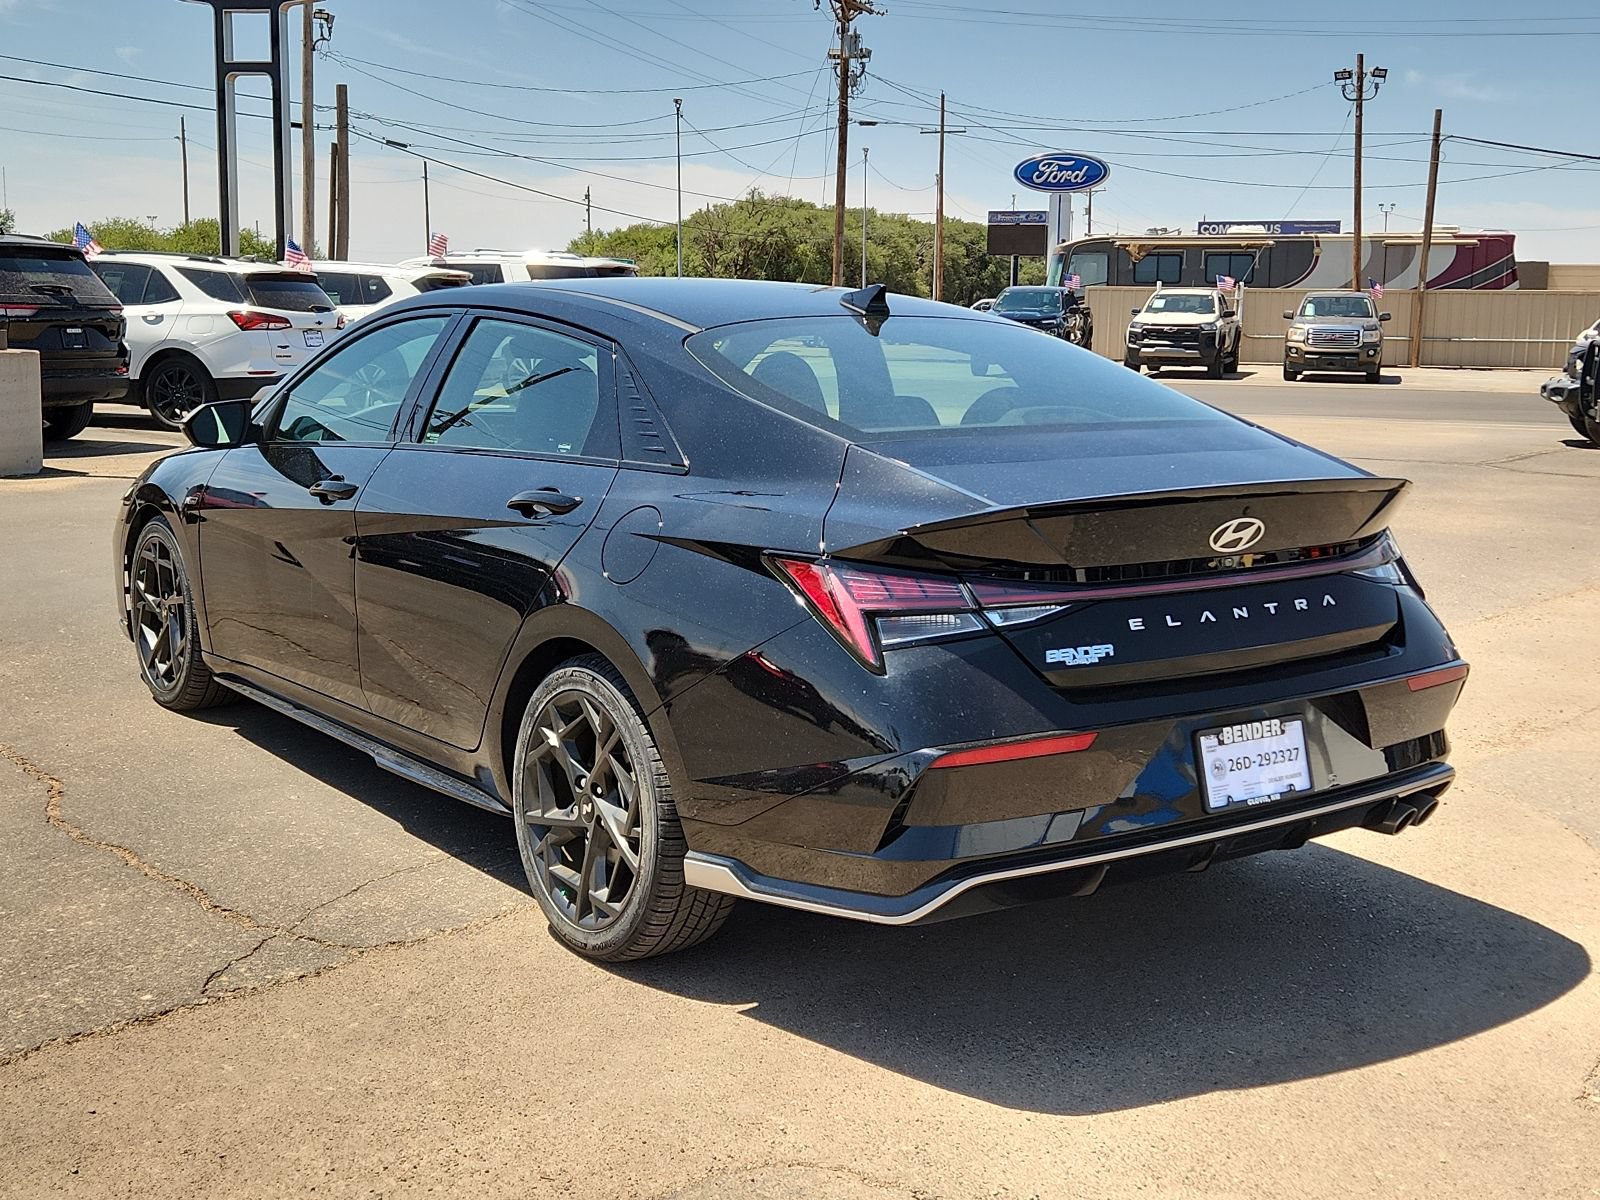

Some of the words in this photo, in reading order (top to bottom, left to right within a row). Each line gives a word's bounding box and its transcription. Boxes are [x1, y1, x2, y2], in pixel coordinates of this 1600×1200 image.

[1032, 160, 1088, 184] Ford
[1128, 594, 1337, 631] ELANTRA
[1045, 643, 1114, 663] BENDER
[1223, 719, 1281, 744] BENDER
[1228, 747, 1300, 772] 26D-292327
[582, 802, 592, 815] N
